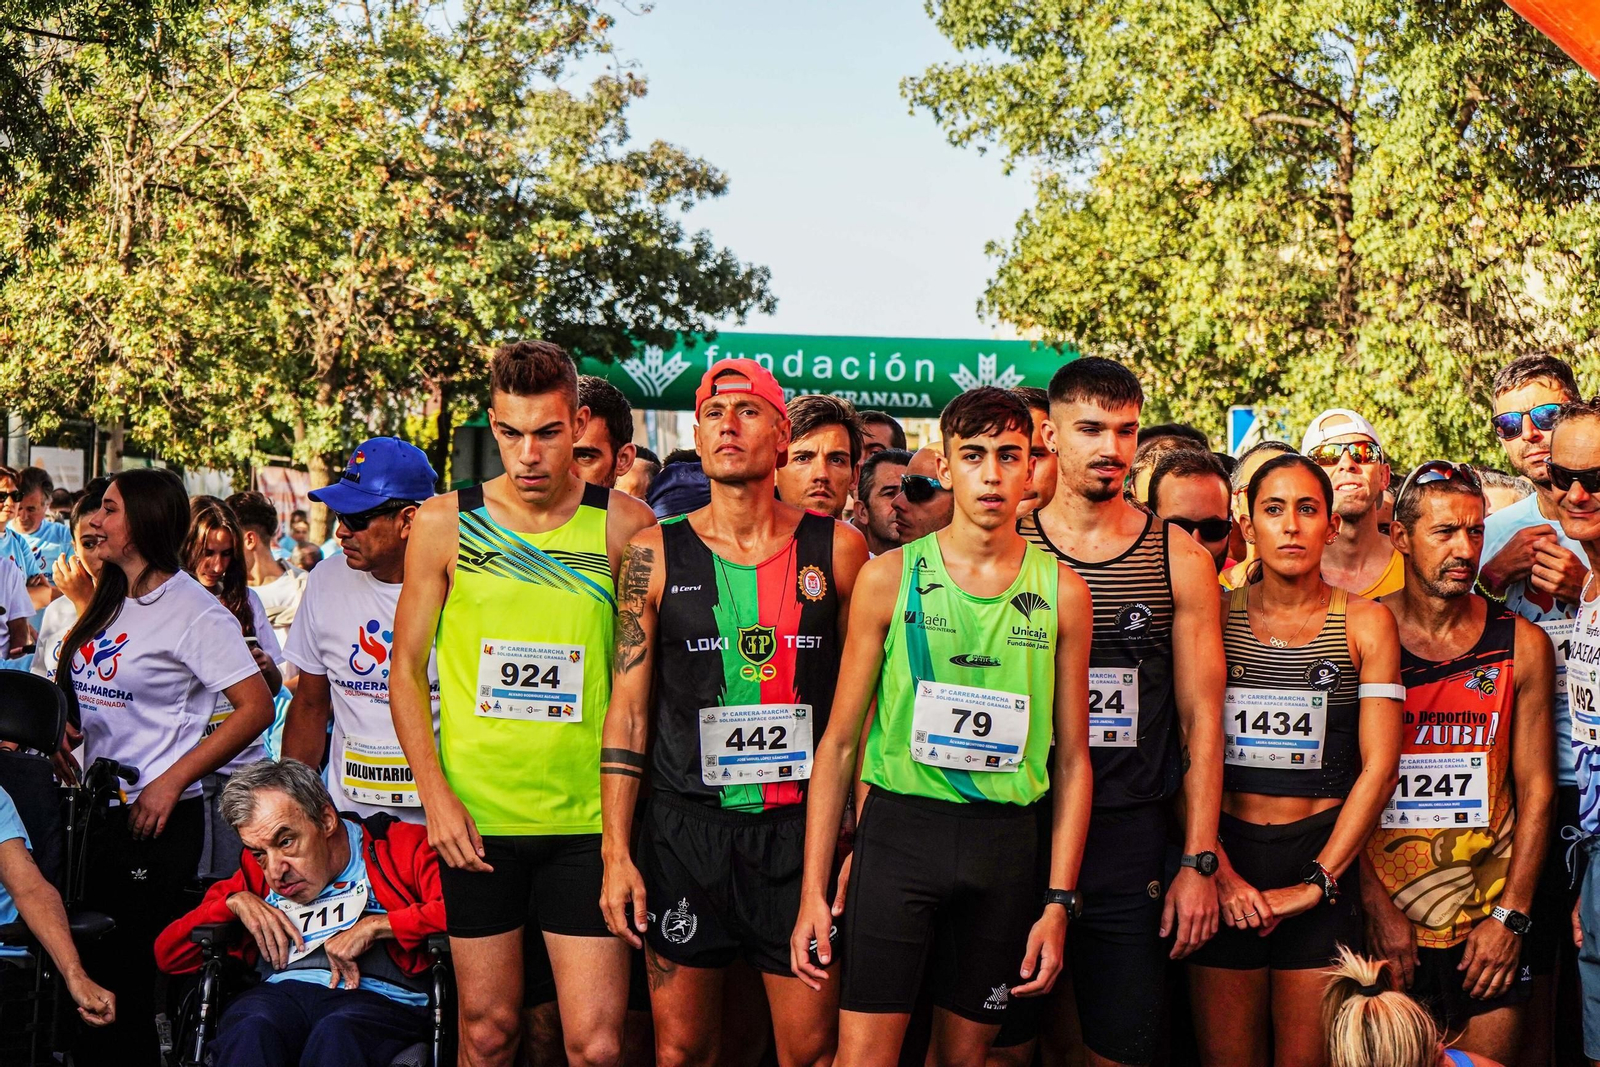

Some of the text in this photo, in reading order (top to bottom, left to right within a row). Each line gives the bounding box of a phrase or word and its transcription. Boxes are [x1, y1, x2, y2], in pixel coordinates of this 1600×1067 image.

[704, 345, 935, 383] fndación
[1135, 603, 1152, 616] JOVEN
[918, 612, 947, 627] Jaén
[1012, 626, 1047, 640] Unicaja
[508, 646, 564, 654] CARRERA-MARCHA
[686, 637, 728, 652] LOKI
[784, 635, 822, 649] TEST
[1322, 660, 1340, 672] JOVEN
[500, 662, 560, 688] 924
[96, 700, 126, 708] GRANADA
[936, 695, 964, 703] SOLIDARIA
[948, 690, 1009, 702] CARRERA-MARCHA
[1089, 690, 1124, 714] 24
[1571, 683, 1596, 712] 1492
[730, 709, 788, 717] CARRERA-MARCHA
[1419, 710, 1487, 726] Deportivo
[952, 708, 992, 736] 79
[1234, 710, 1312, 737] 1434
[726, 726, 787, 752] 442
[346, 762, 414, 782] VOLUNTARIO
[1398, 774, 1472, 798] 1247
[300, 902, 344, 932] 711
